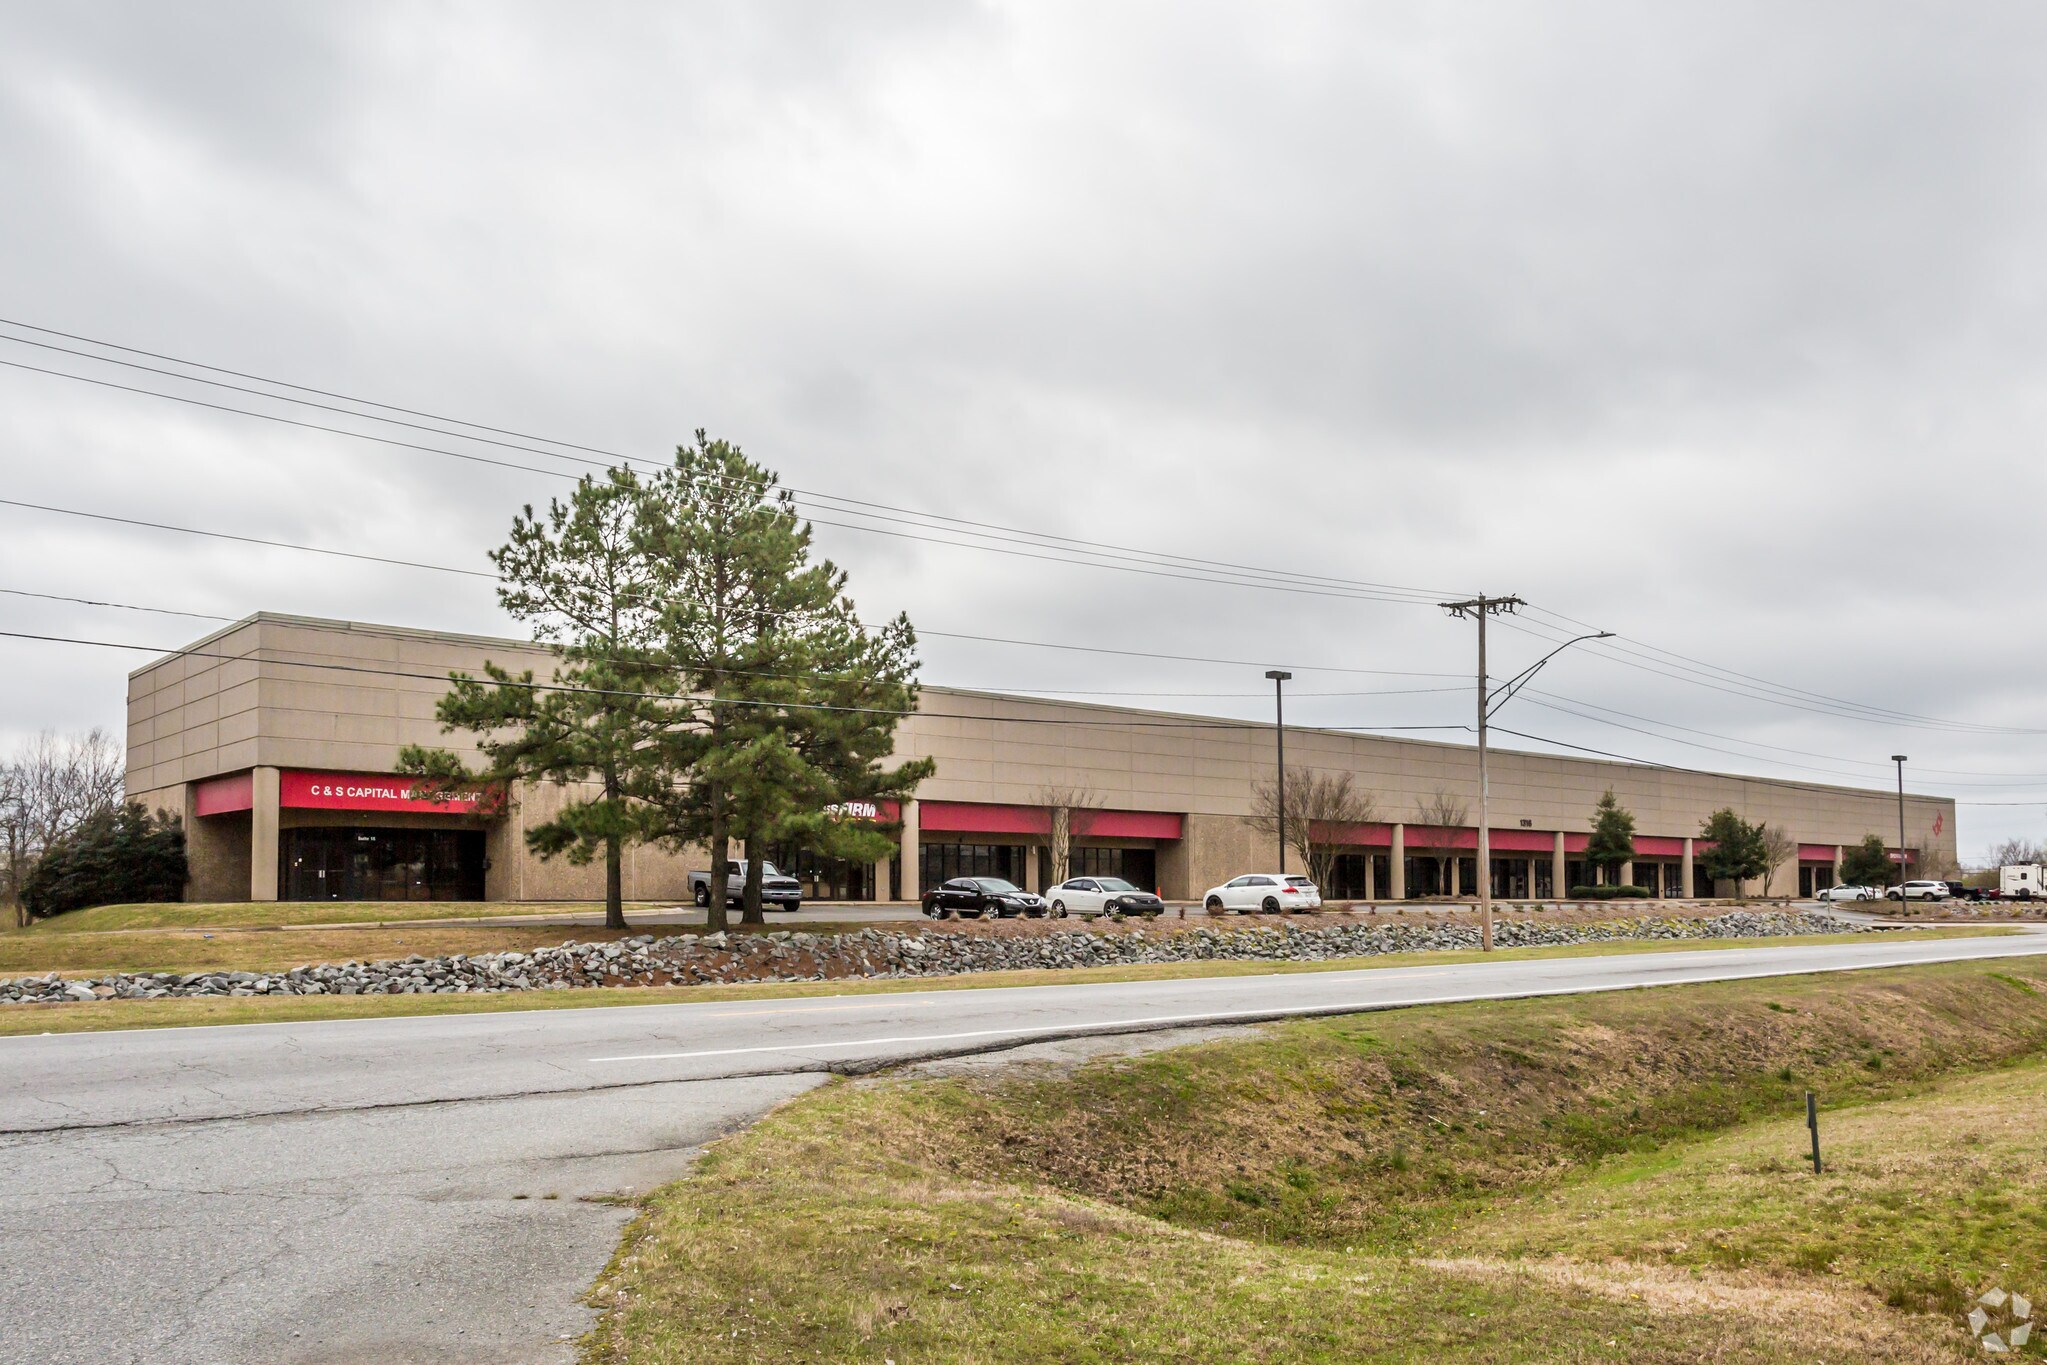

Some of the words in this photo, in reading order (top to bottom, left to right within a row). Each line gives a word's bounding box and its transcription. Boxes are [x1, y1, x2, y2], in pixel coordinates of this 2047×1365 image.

[311, 785, 320, 796] C
[323, 786, 332, 796] &
[335, 786, 344, 796] S
[346, 787, 398, 799] CAPITAL
